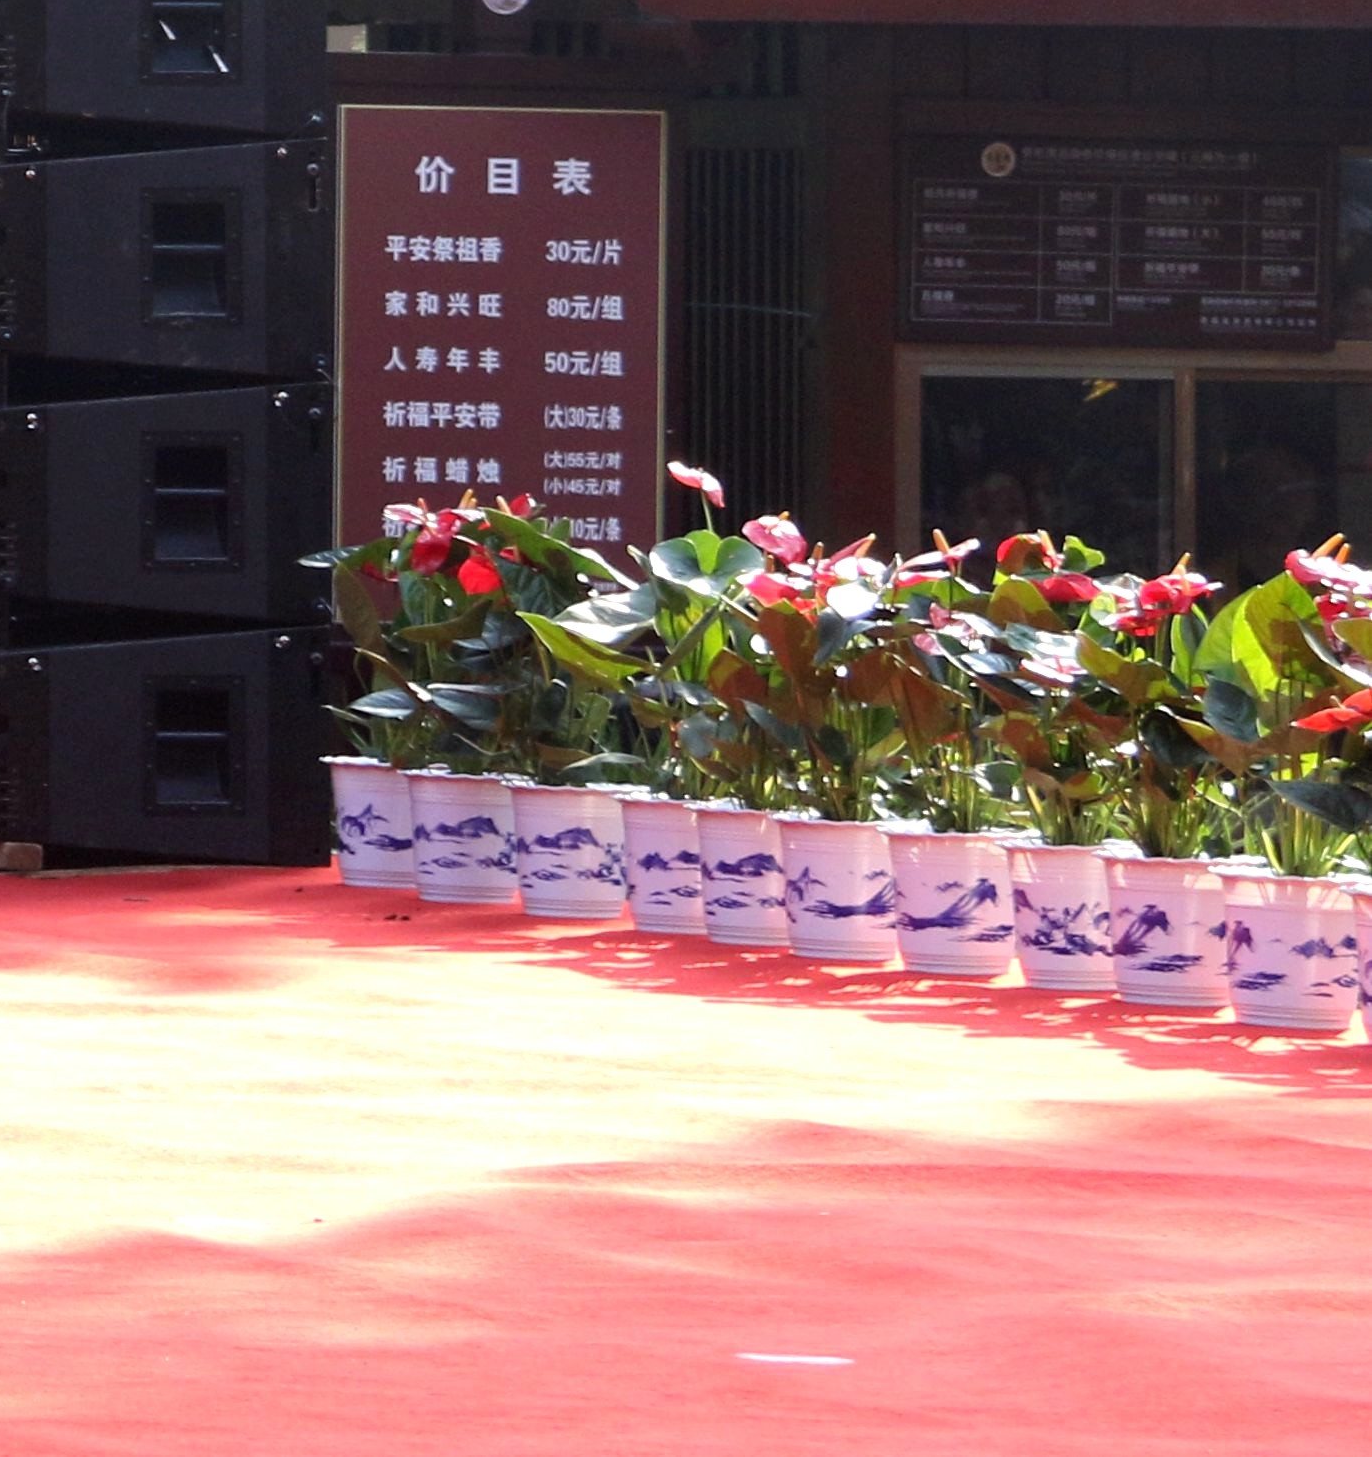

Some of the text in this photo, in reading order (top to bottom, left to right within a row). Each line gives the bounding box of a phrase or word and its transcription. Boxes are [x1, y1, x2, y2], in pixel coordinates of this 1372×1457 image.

[415, 156, 591, 195] 价目表
[385, 235, 622, 264] 平安祭祖香 30元/片
[385, 291, 623, 320] 家和兴旺 80元/组
[384, 346, 623, 376] 人寿年丰 50元/组
[383, 401, 500, 428] 祈福平安带
[383, 457, 500, 483] 祈福蜡烛
